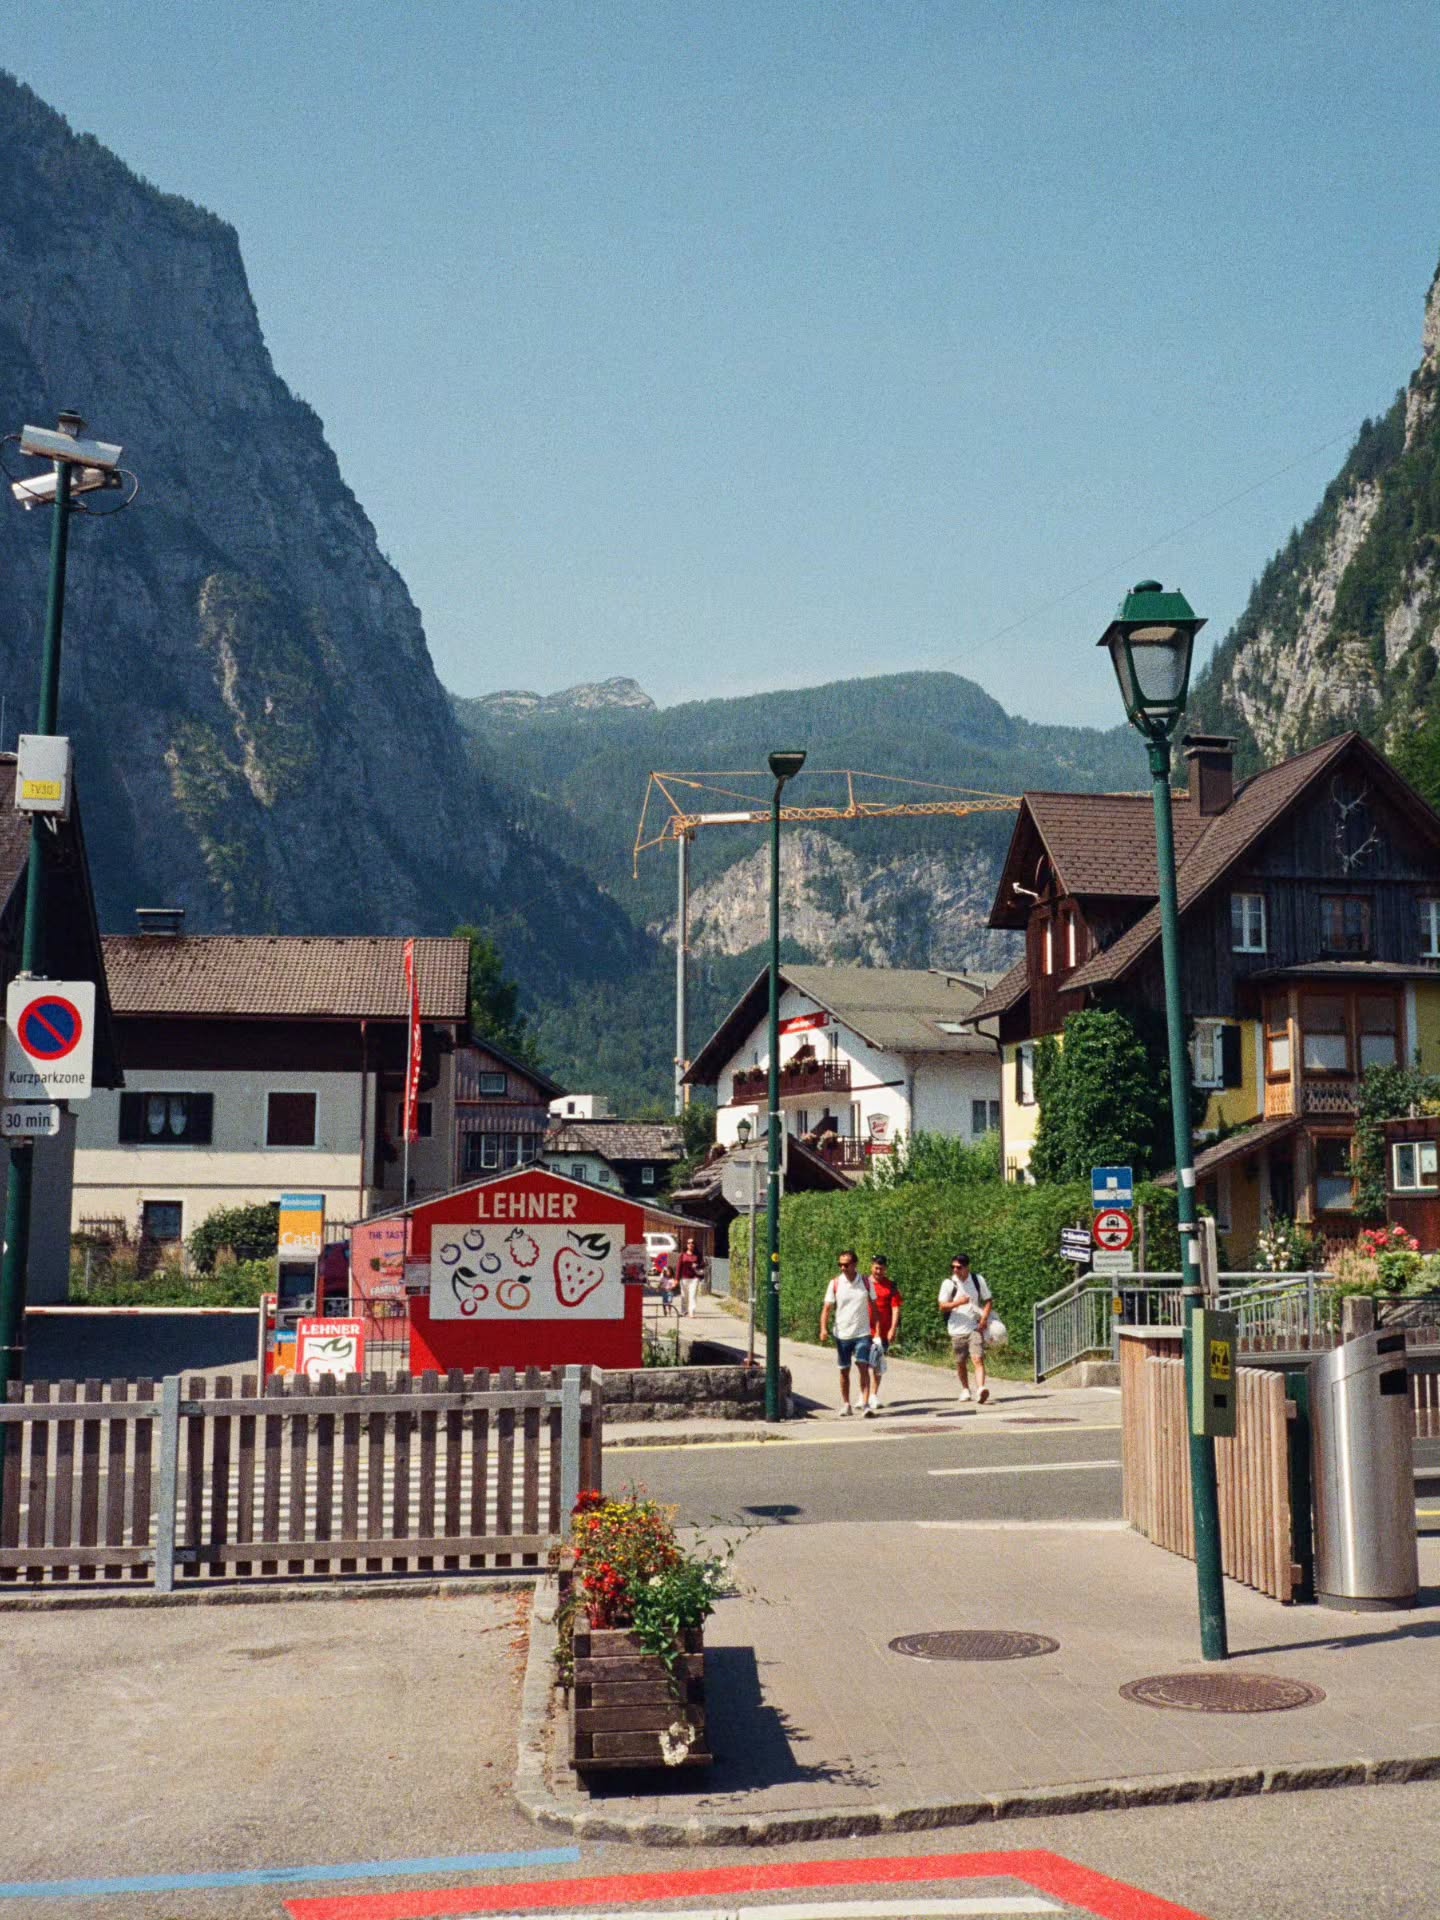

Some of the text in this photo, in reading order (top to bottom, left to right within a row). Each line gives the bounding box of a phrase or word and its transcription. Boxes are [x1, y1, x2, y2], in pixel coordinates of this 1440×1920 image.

[9, 1071, 86, 1086] Kurzparkzone
[6, 1112, 55, 1128] 30 min.
[478, 1192, 578, 1218] LEHNER
[281, 1232, 322, 1248] Cash
[369, 1230, 382, 1239] THE
[301, 1324, 361, 1335] LEHNER
